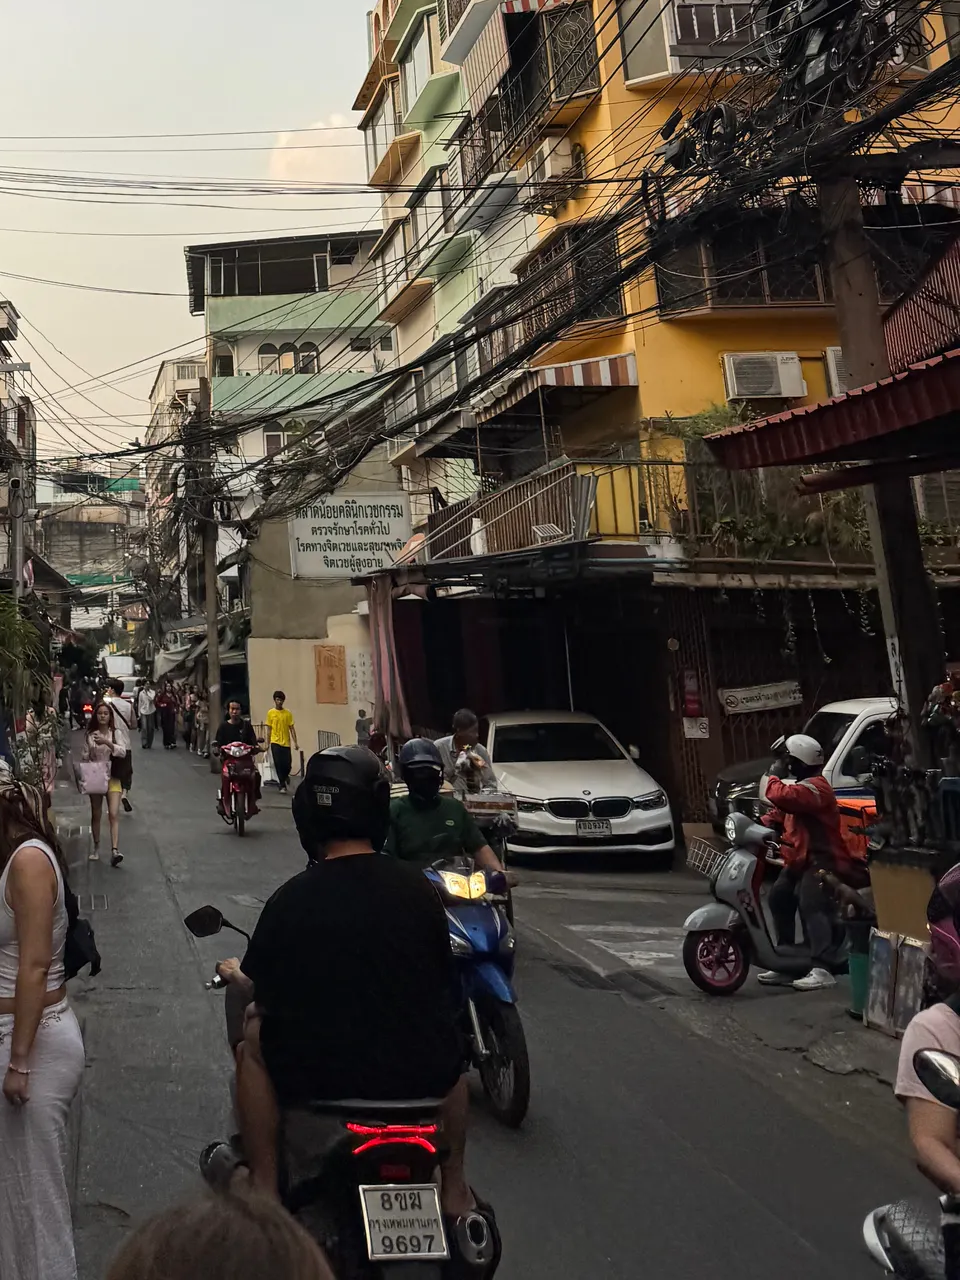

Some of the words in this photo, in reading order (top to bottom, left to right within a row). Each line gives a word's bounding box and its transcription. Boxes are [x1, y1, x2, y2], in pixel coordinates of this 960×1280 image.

[311, 520, 390, 536] ตรวจรักษาโรคทั่วไป
[323, 554, 384, 572] จิตเวชผู้สูงอาย
[369, 1217, 439, 1233] กรุงเทพมหานคร
[381, 1234, 435, 1254] 9697
